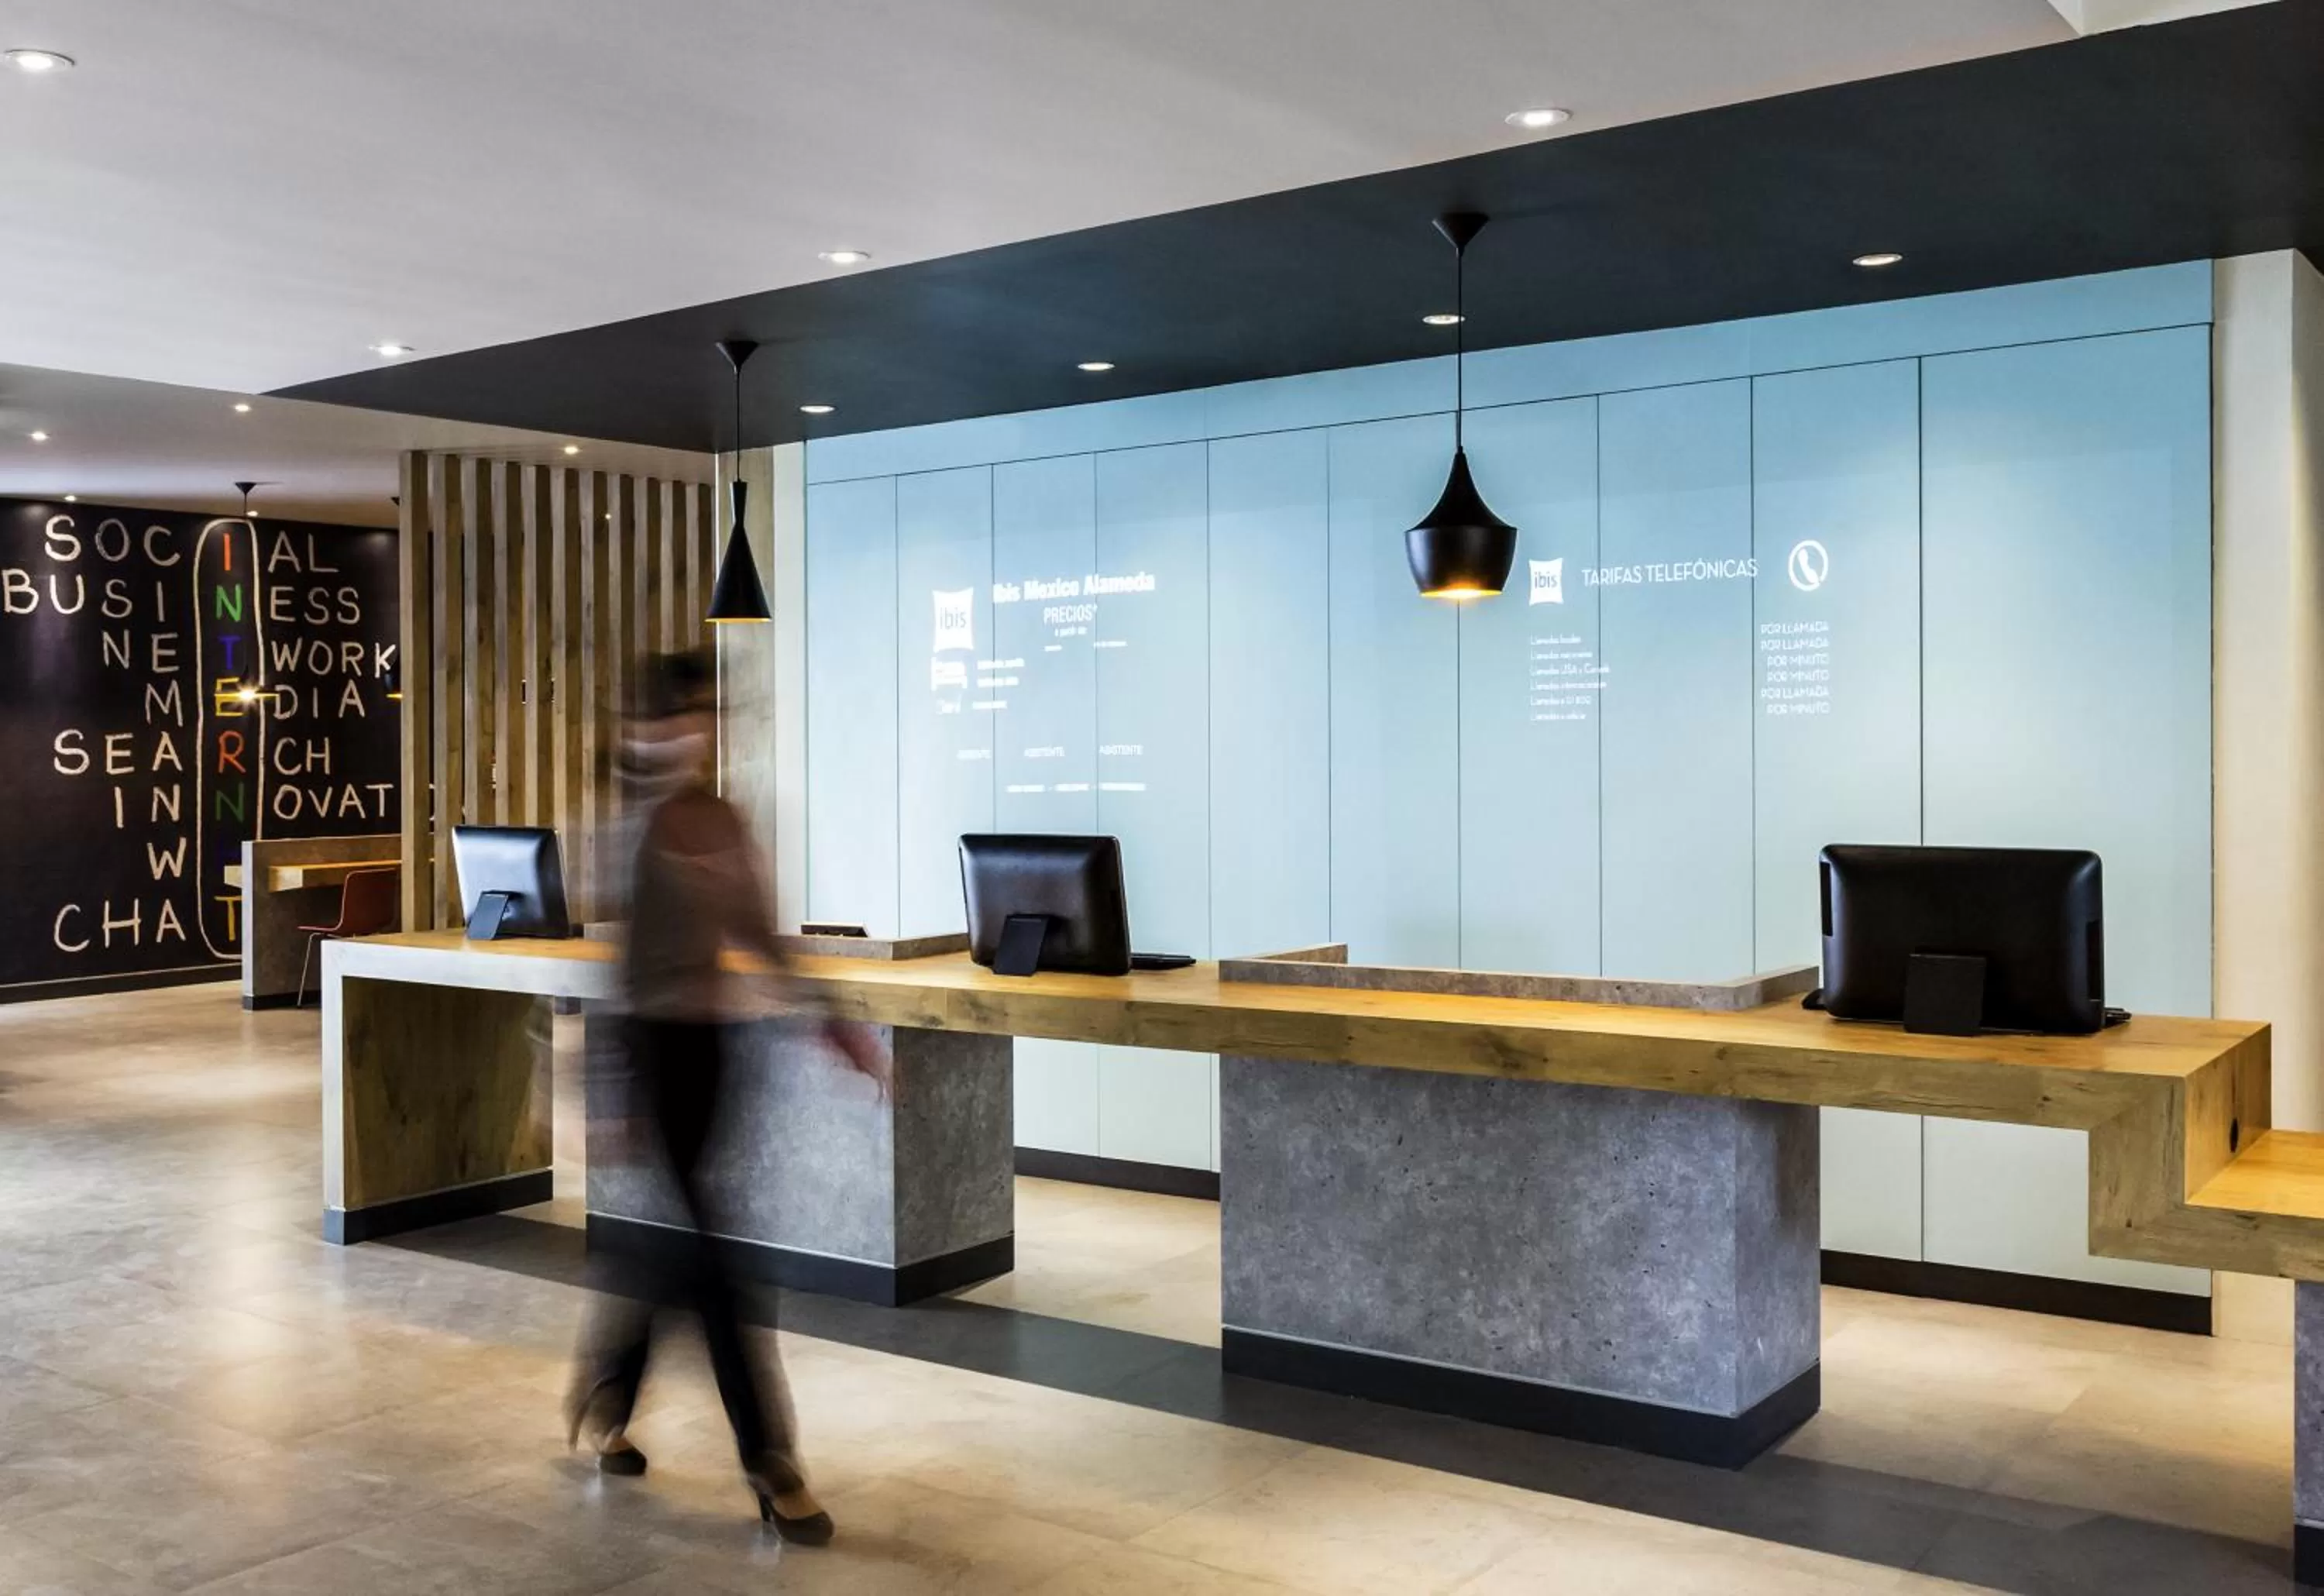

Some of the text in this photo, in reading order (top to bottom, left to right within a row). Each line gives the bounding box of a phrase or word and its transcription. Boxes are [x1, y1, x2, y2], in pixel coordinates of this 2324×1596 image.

[1534, 569, 1559, 590] ibis
[1582, 557, 1759, 588] TARIFAS TELEFÓNICAS
[939, 607, 967, 631] ibis
